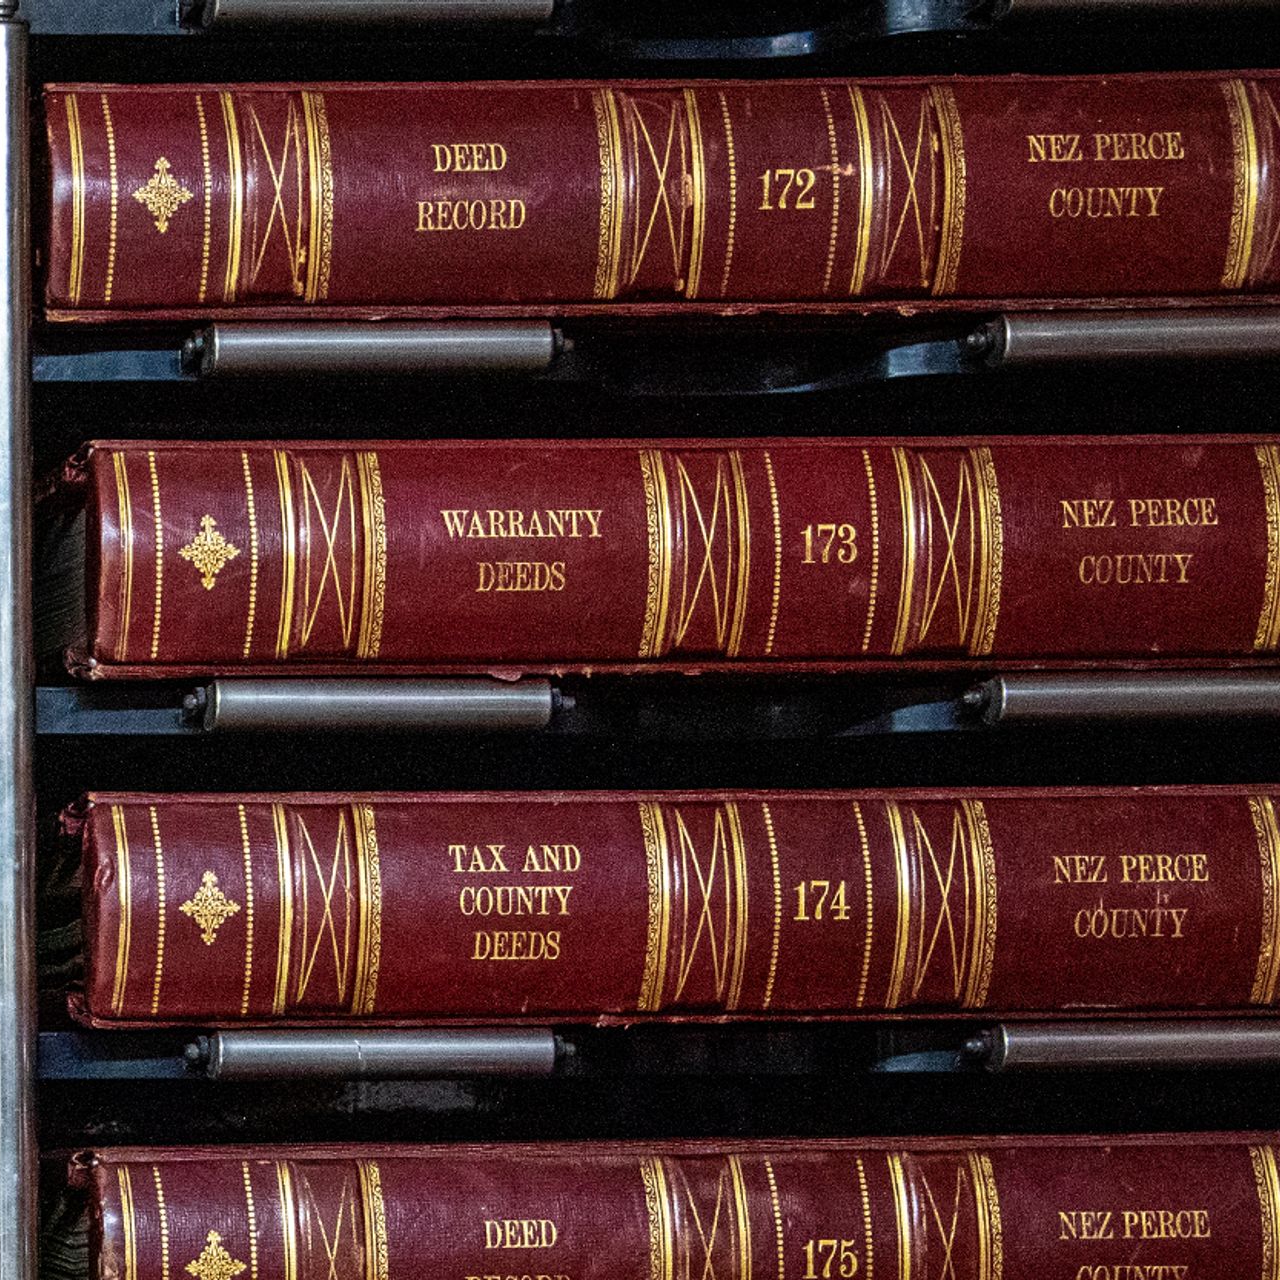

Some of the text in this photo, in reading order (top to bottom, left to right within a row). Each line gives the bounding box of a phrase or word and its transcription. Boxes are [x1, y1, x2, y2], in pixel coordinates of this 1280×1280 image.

[432, 144, 506, 172] DEED
[1027, 132, 1184, 163] NEZ PERCE
[758, 169, 816, 210] 172
[1049, 188, 1164, 217] COUNTY
[416, 200, 526, 232] RECORD
[441, 510, 602, 538] WARRANTY
[1062, 499, 1218, 528] NEZ PERCE
[800, 525, 858, 564] 173
[476, 562, 565, 592] DEEDS
[1079, 554, 1193, 584] COUNTY
[449, 845, 581, 872] TAX AND
[1054, 854, 1209, 882] NEZ PERCE
[459, 886, 573, 917] COUNTY
[792, 881, 850, 921] 174
[1074, 909, 1188, 939] COUNTY
[471, 931, 560, 961] DEEDS
[484, 1220, 557, 1249] DEED
[1058, 1210, 1211, 1241] NEZ PERCE
[801, 1240, 858, 1279] 175
